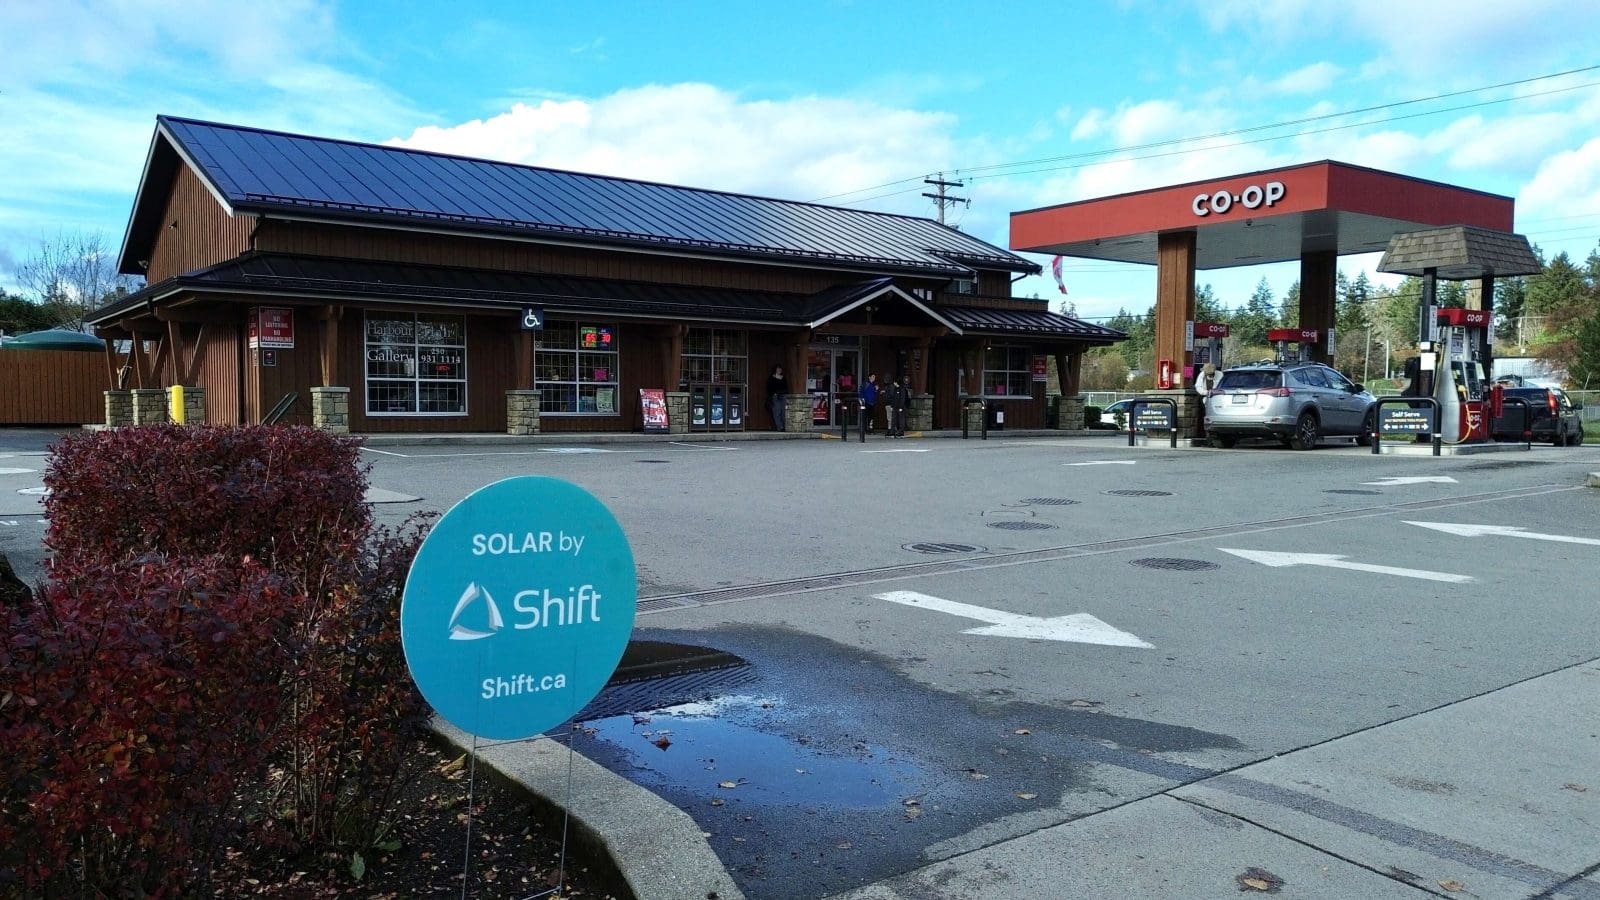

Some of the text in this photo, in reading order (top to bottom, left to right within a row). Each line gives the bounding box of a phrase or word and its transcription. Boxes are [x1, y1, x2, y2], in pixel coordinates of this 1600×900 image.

[1192, 181, 1285, 216] CO-OP
[1467, 313, 1483, 322] CO-OP
[367, 322, 413, 336] Harbour
[367, 349, 413, 362] Gallery
[421, 355, 460, 364] 931 1114
[472, 530, 585, 557] SOLAR by
[513, 584, 601, 630] Shift
[481, 673, 566, 699] Shift.ca
